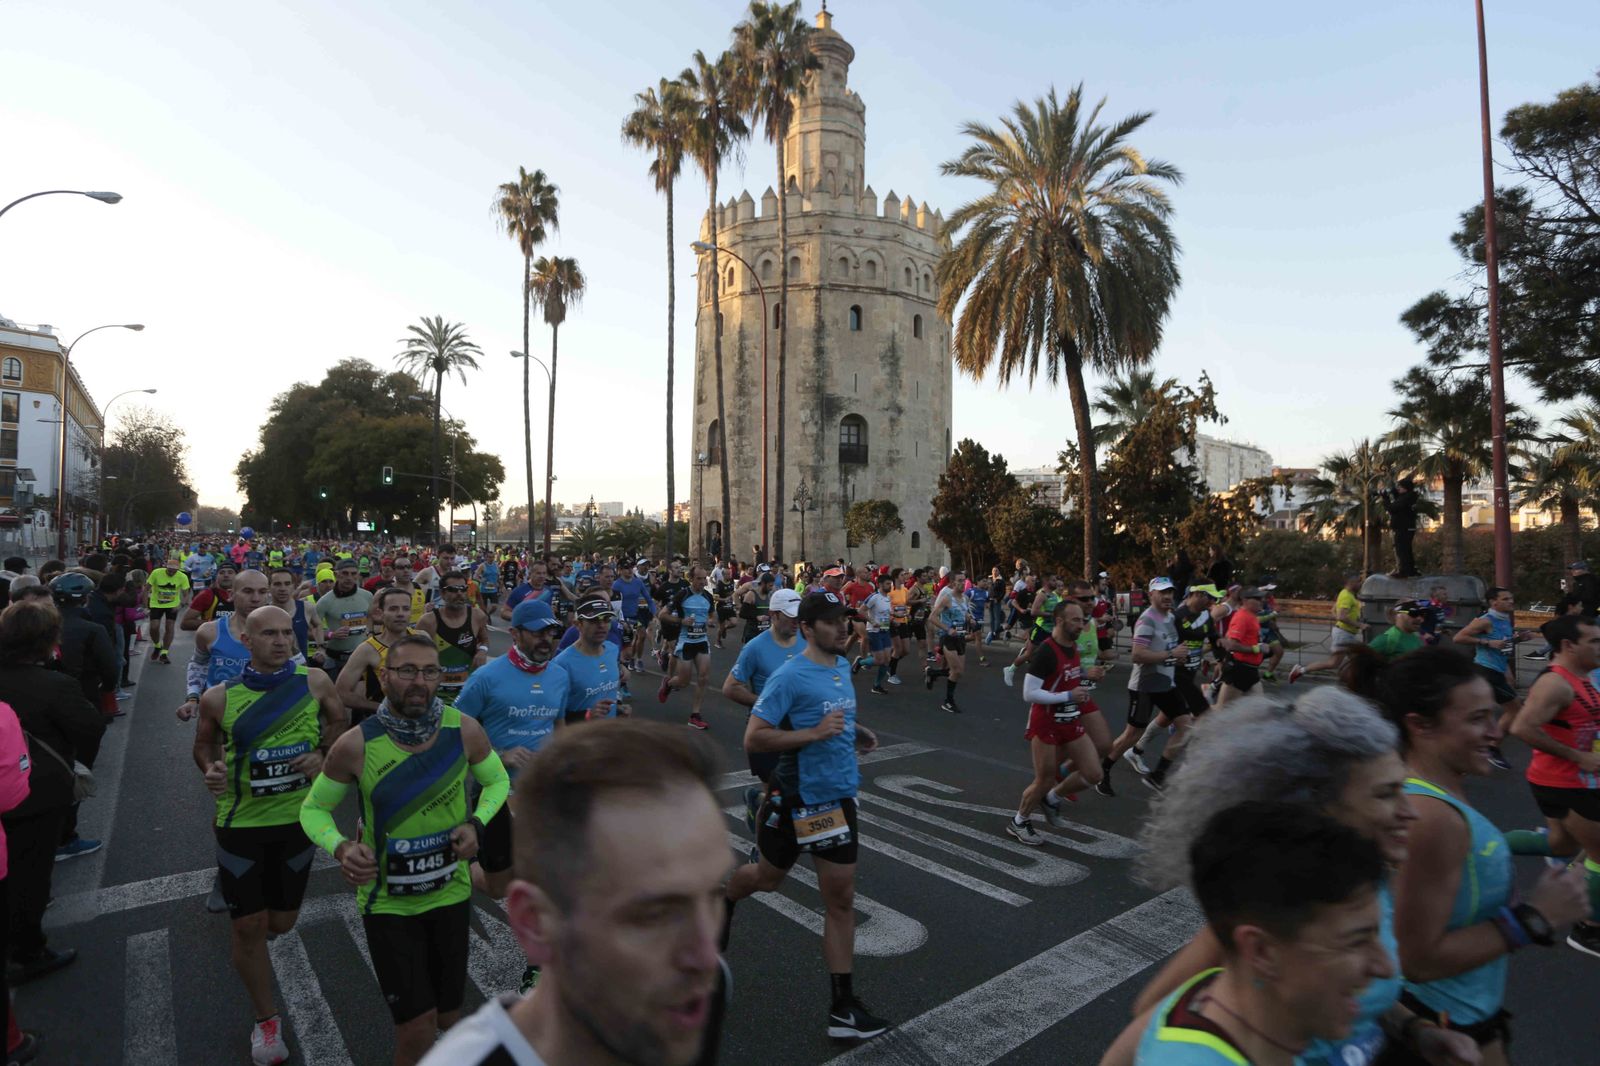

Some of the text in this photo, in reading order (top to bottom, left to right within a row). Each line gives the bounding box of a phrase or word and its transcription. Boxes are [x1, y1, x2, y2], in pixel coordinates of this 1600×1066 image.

[271, 744, 305, 757] ZURICH
[265, 763, 294, 777] 127
[808, 816, 834, 833] 3509
[406, 852, 445, 873] 1445
